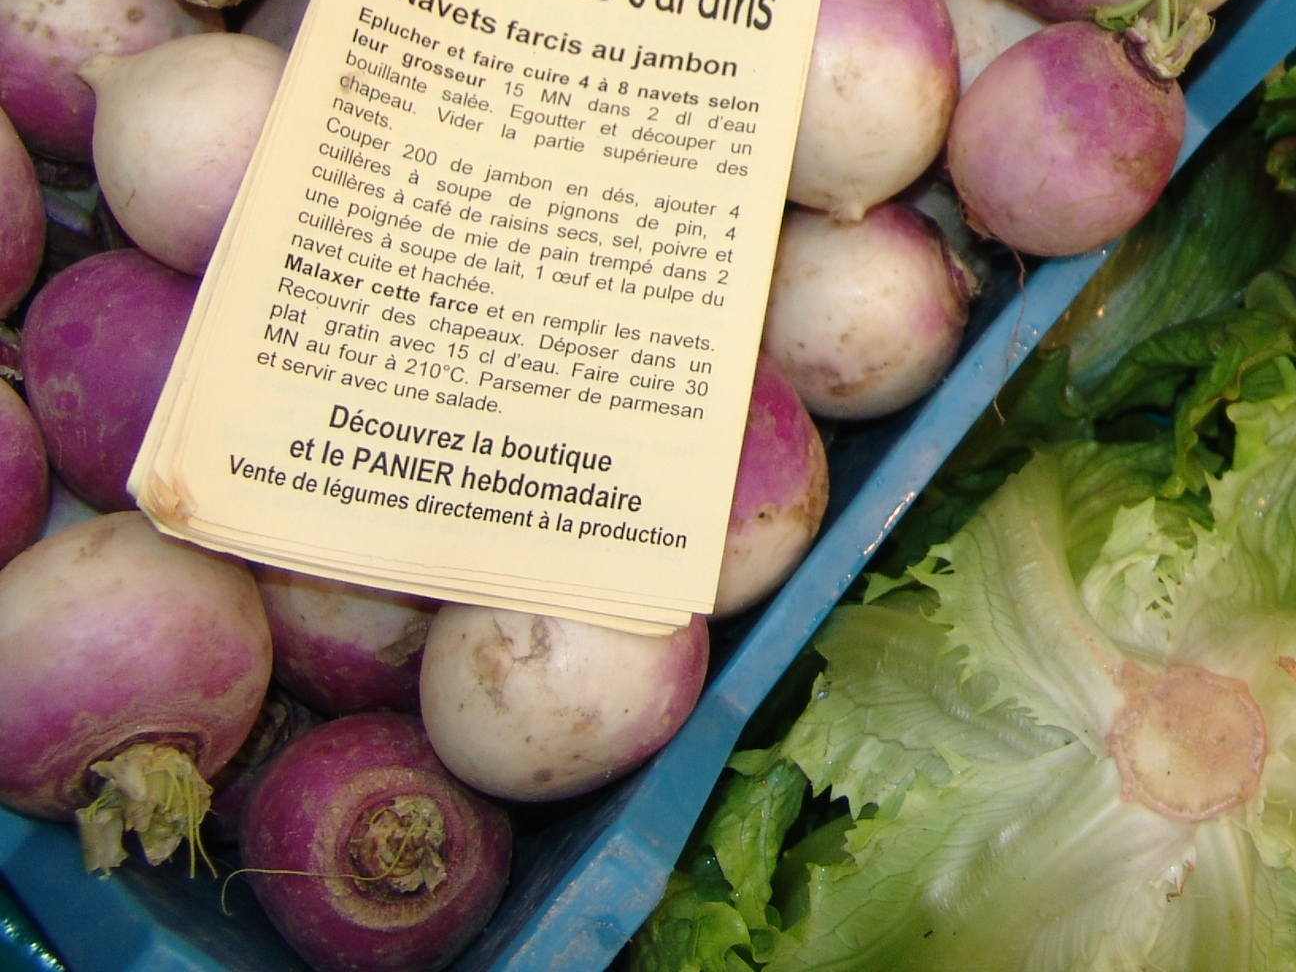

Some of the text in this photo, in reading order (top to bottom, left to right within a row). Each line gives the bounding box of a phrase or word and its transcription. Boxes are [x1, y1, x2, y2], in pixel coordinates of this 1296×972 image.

[352, 28, 756, 134] leur grosseur 15 MN dans 2 dl d'eau
[358, 6, 759, 112] Eplucher et faire cuire 4 à 8 navets selon
[507, 20, 582, 55] farcis
[592, 44, 625, 62] au
[630, 45, 737, 77] jambon
[333, 98, 392, 130] navets.
[340, 75, 748, 176] chapeau. Vider la partie supérieure des
[346, 50, 752, 155] bouillante salée. Egoutter et découper un
[312, 166, 733, 263] cuillères à café de raisins secs, sel, poivre et
[327, 117, 739, 219] Couper 200 de jambon en dés, ajouter 4
[291, 234, 493, 294] navet cuite et hachée.
[298, 212, 373, 244] cuillères
[380, 233, 392, 249] à
[400, 242, 456, 264] soupe
[464, 253, 487, 269] de
[494, 257, 524, 278] lait,
[536, 265, 543, 279] 1
[596, 277, 614, 291] et
[621, 278, 636, 294] la
[643, 285, 694, 304] pulpe
[702, 290, 724, 306] du
[306, 188, 728, 284] une poignée de mie de pain trempé dans 2
[278, 277, 712, 374] Recouvrir des chapeaux. Déposer dans un
[284, 253, 714, 351] Malaxer cette farce et en remplir les navets.
[257, 352, 501, 413] et servir avec une salade.
[264, 324, 703, 419] MN au four à 210°C. Parsemer de parmesan
[269, 304, 708, 396] plat gratin avec 15 cl d'eau. Faire cuire 30
[290, 438, 642, 512] et le PANIER hebdomadaire
[329, 404, 612, 474] Découvrez la boutique
[230, 454, 686, 548] Vente de légumes directement à la production
